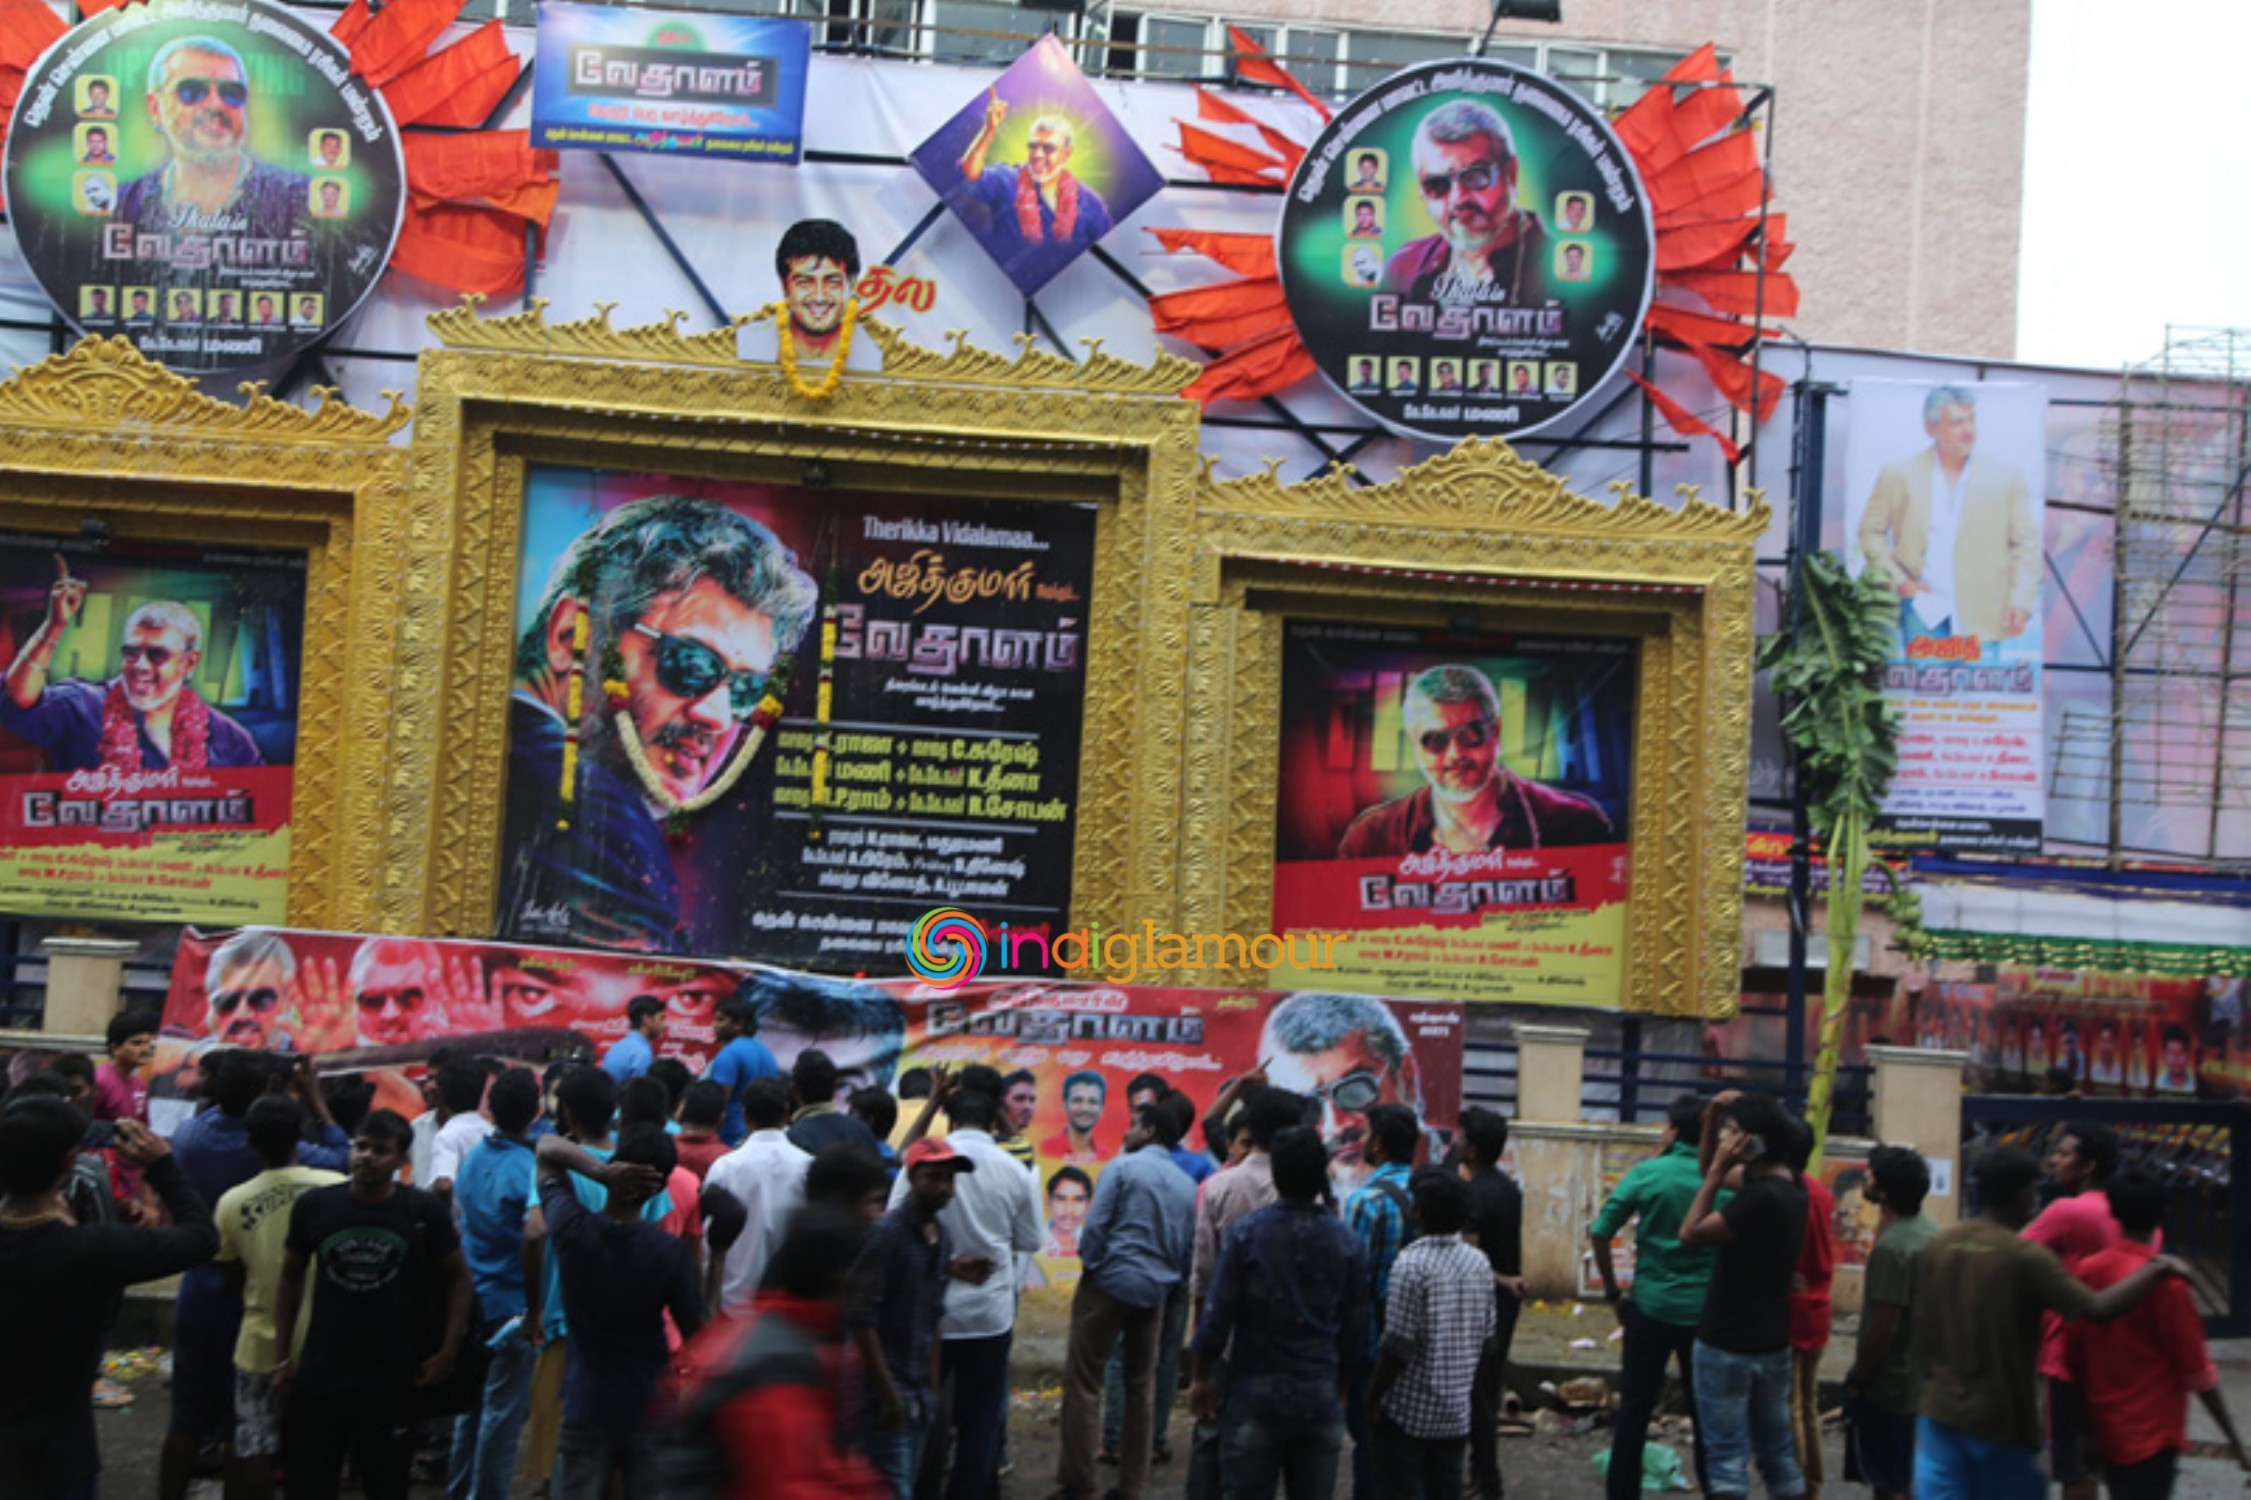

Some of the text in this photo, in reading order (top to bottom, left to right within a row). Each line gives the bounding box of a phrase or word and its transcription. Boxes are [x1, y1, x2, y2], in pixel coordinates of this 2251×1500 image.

[575, 49, 761, 97] வேதாளம்
[104, 223, 308, 269] வேதாளம்
[855, 266, 936, 318] தல
[1370, 295, 1563, 340] வேதாளம்
[863, 515, 938, 543] Therikka
[857, 548, 1037, 615] அஜித்குமார்
[834, 603, 1079, 676] வேதாளம்
[23, 790, 249, 832] வேதாளம்
[1360, 869, 1570, 913] வேதாளம்
